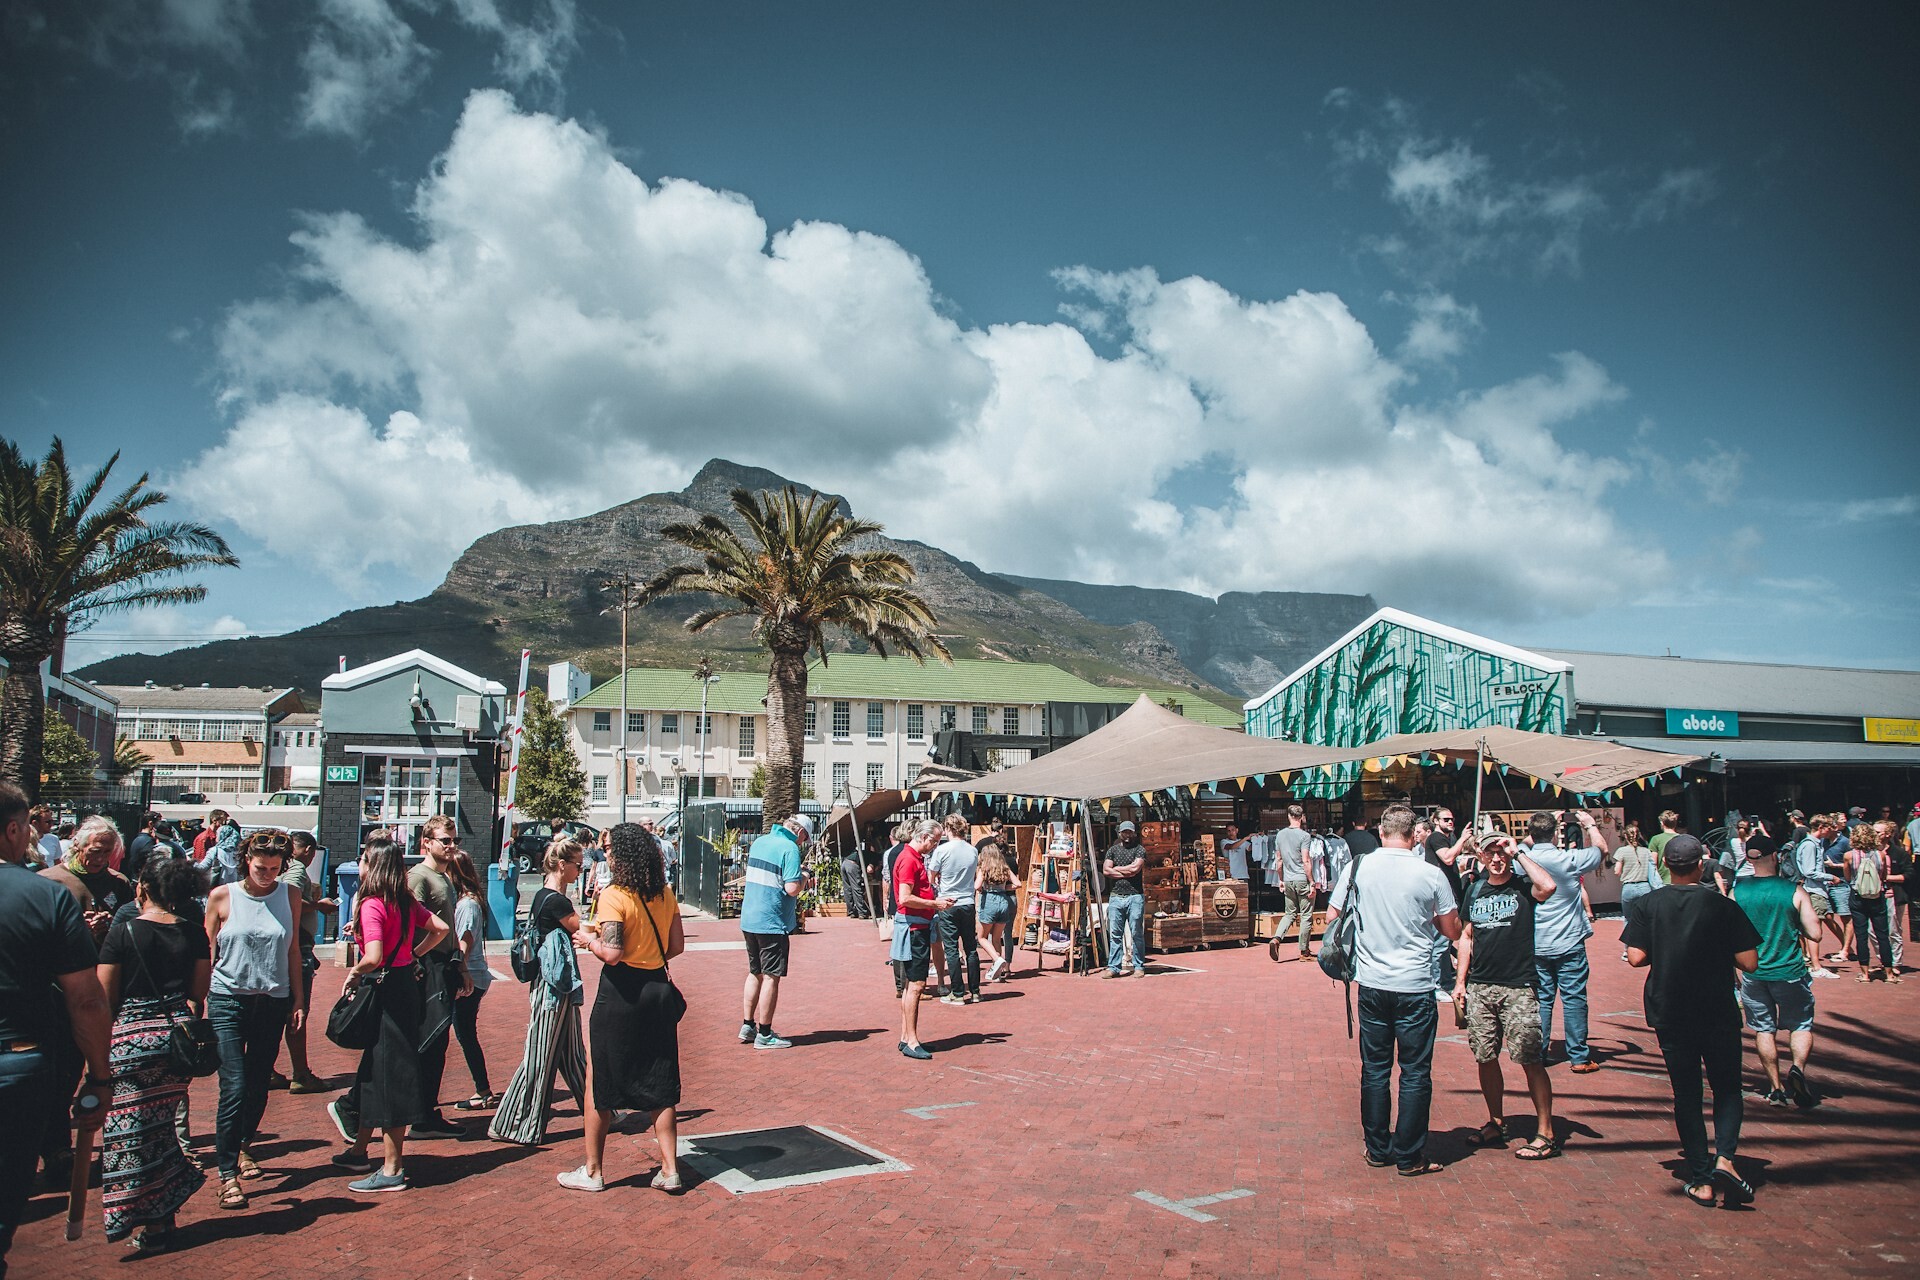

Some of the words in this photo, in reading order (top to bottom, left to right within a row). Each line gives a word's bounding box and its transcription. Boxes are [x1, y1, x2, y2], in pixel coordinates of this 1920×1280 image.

[1494, 687, 1501, 696] E
[1505, 682, 1543, 696] BLOCK
[1682, 714, 1726, 732] abode
